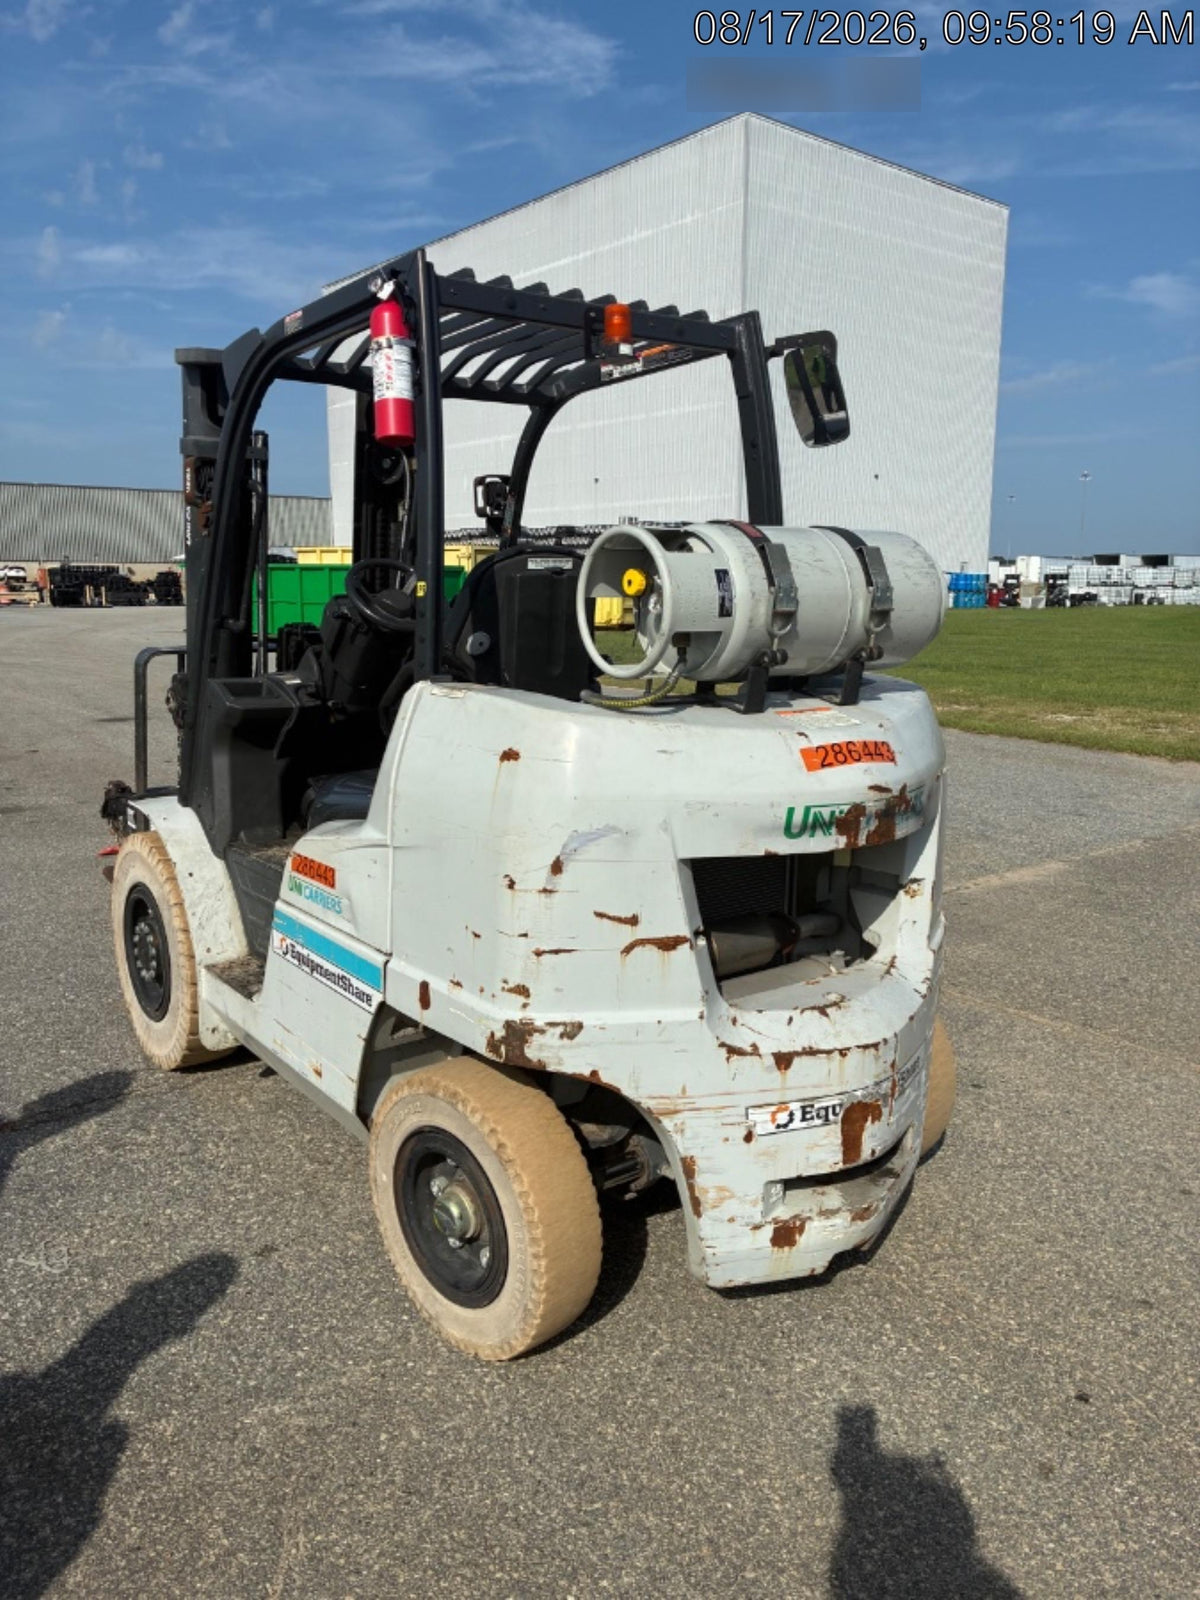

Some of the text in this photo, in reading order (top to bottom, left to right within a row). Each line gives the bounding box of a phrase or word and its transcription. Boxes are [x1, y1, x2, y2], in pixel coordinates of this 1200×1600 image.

[815, 741, 898, 769] 286443
[293, 854, 336, 889] 286443
[289, 943, 373, 1007] EquipmentShare
